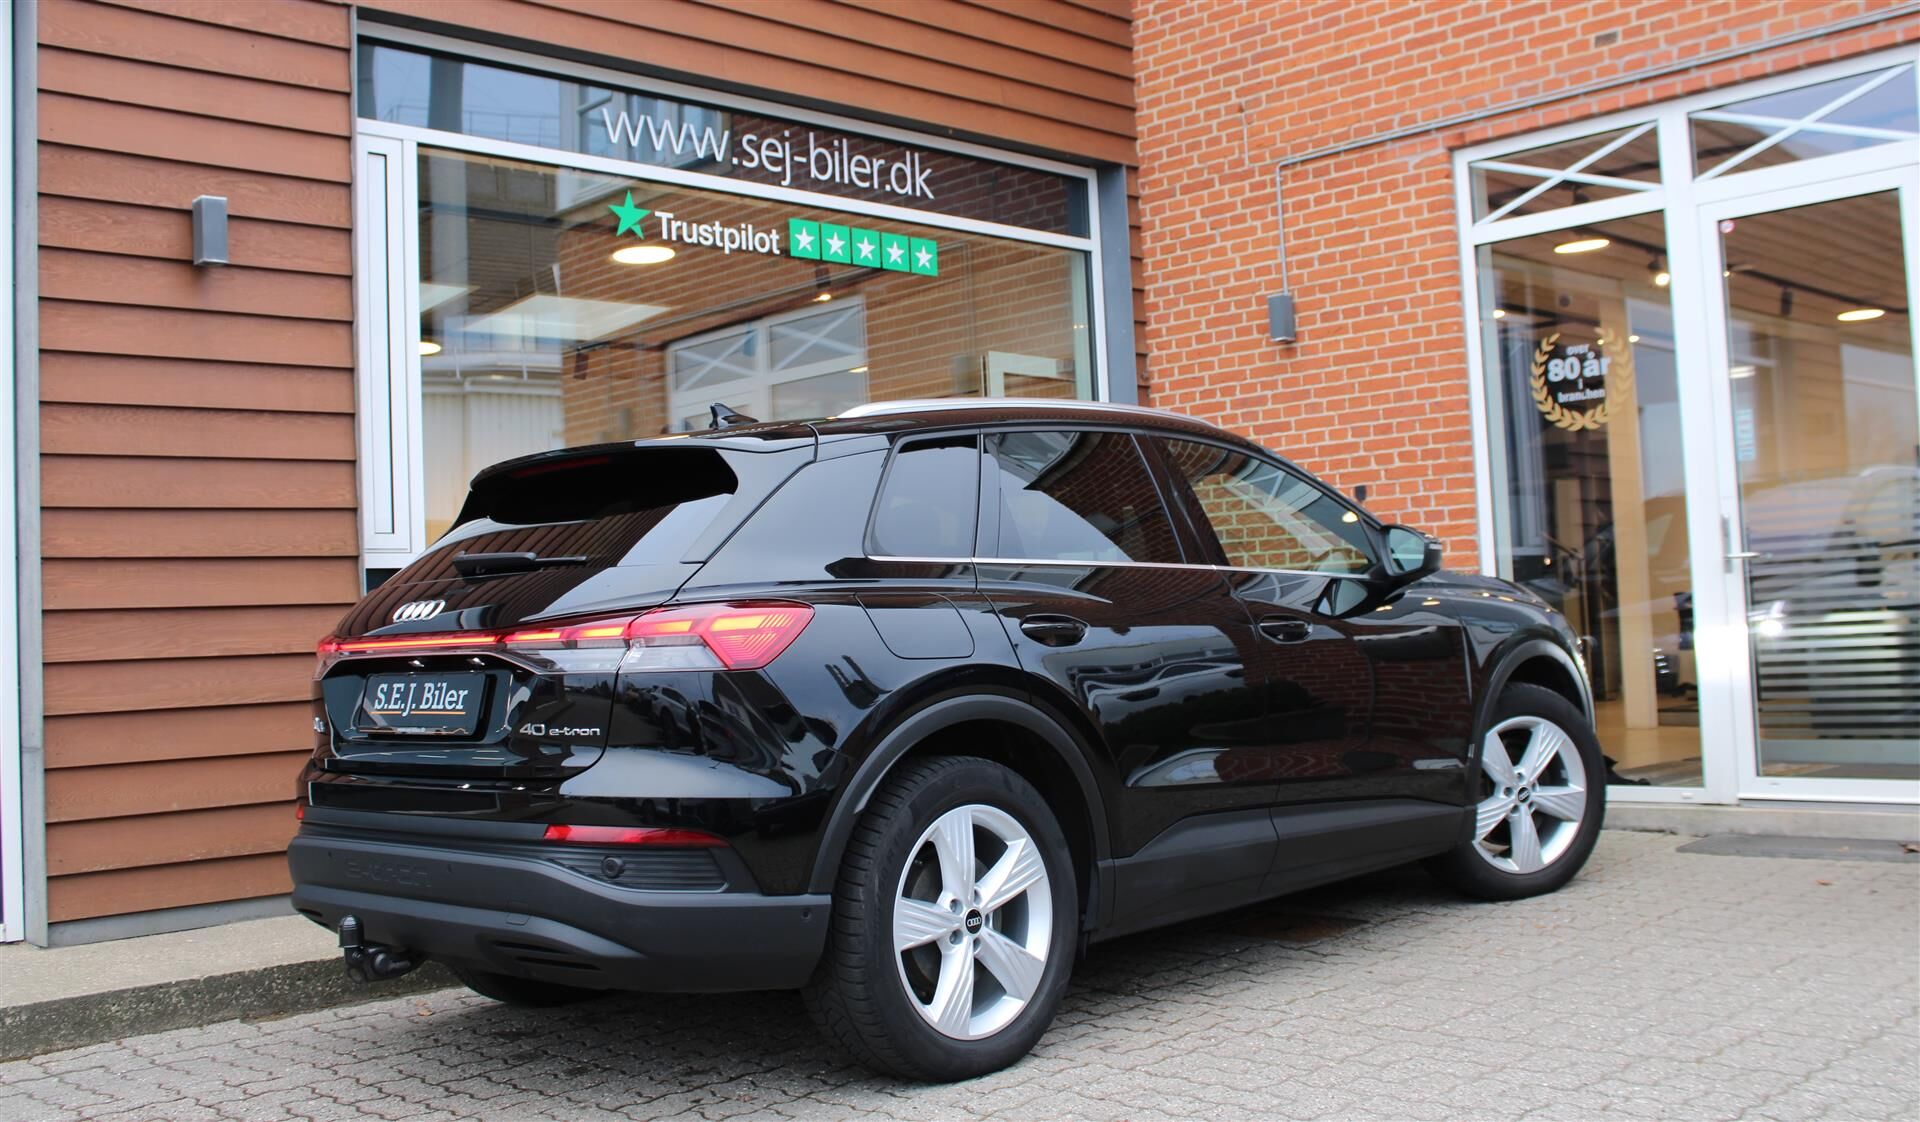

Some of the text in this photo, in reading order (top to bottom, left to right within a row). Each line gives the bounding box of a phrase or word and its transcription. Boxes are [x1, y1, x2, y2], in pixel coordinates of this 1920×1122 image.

[603, 108, 934, 199] www.sej-biler.dk
[655, 211, 780, 255] Trustpilot
[1566, 344, 1590, 355] over
[1548, 351, 1612, 382] 80 år
[374, 682, 469, 717] S.E.J. Biler
[519, 723, 601, 736] 40 e-tron
